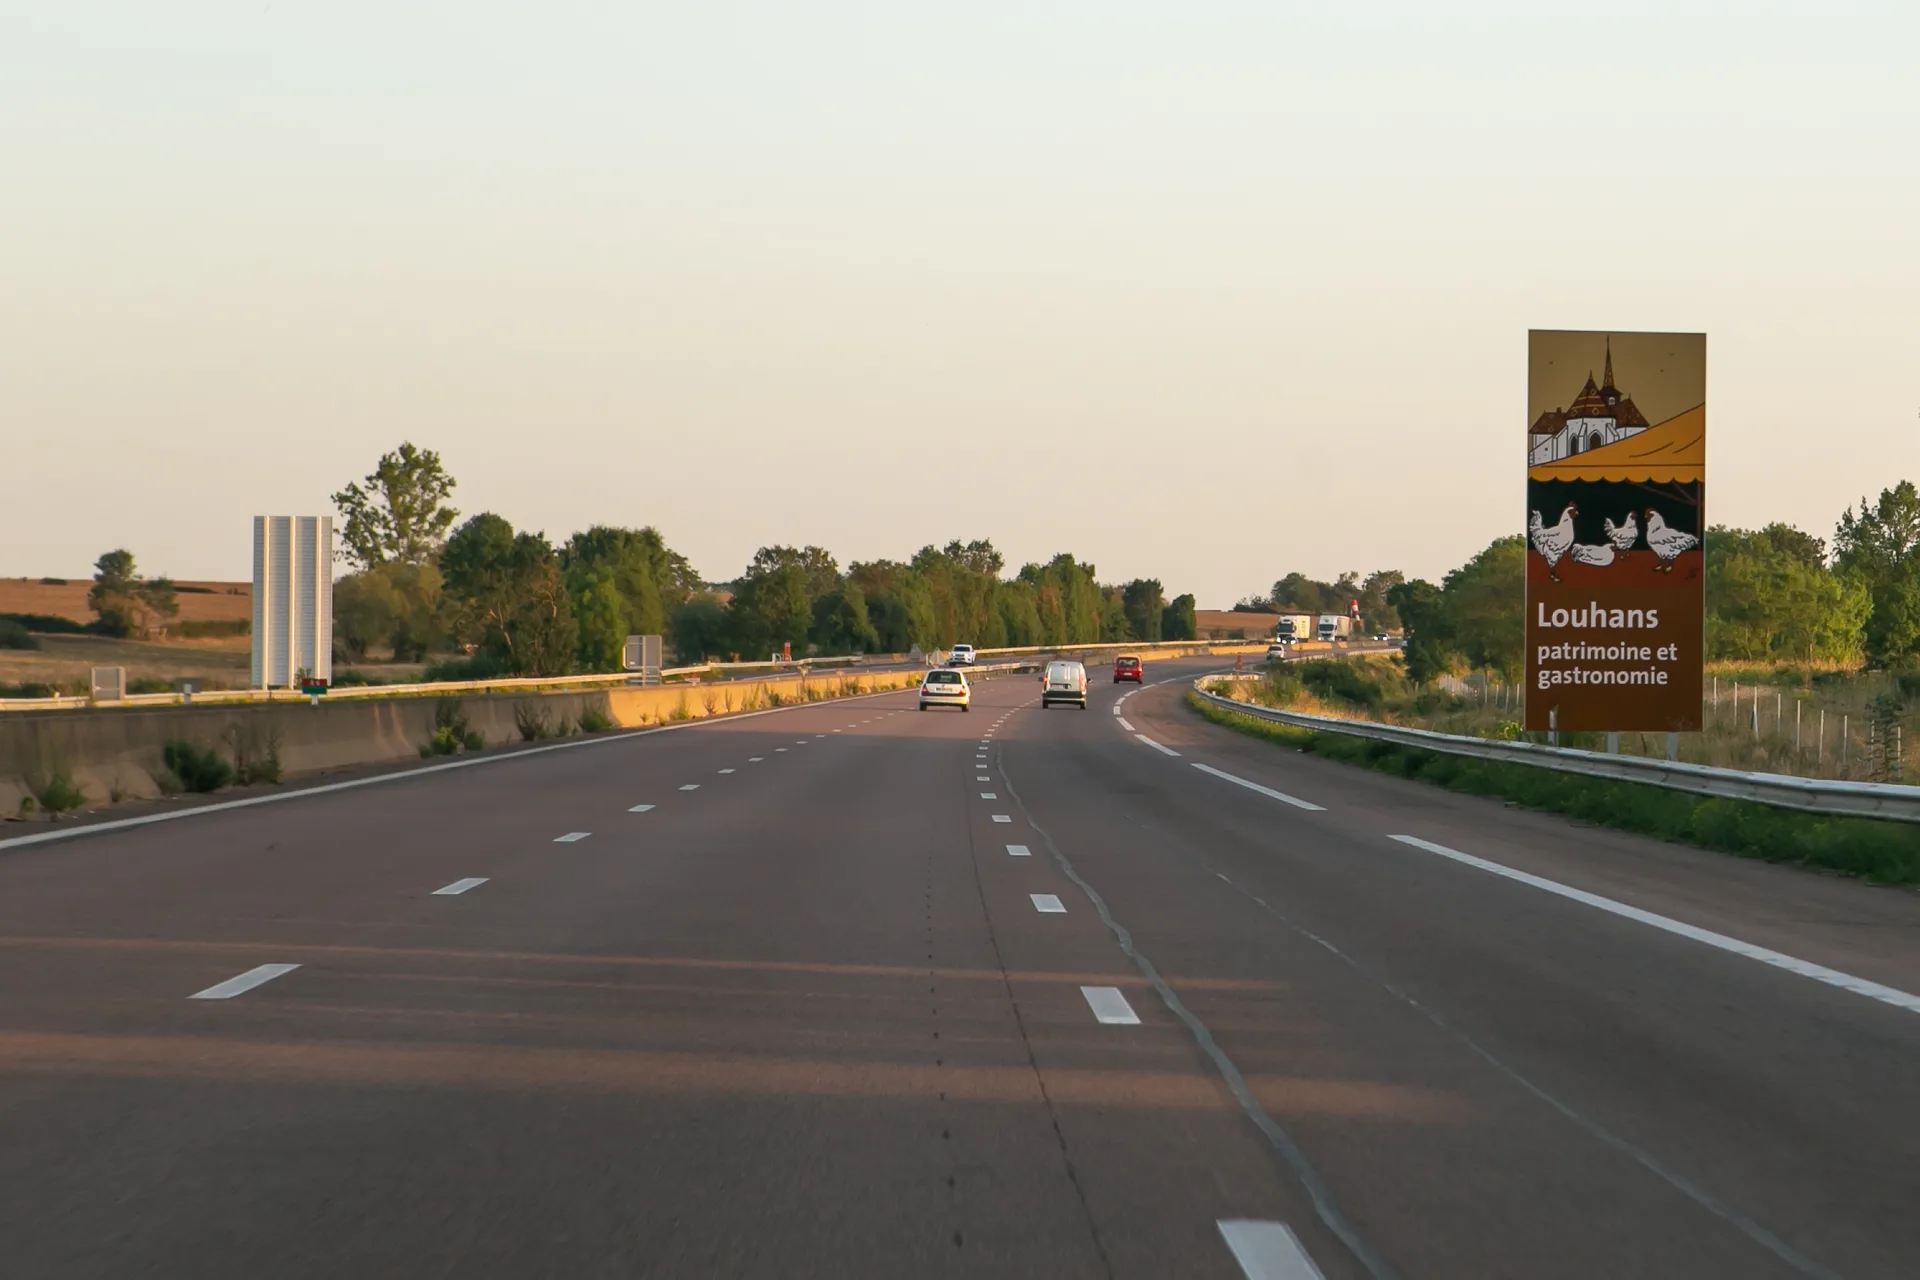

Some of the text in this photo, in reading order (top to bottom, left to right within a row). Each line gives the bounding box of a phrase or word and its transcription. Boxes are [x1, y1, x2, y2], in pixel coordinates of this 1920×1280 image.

[1538, 601, 1659, 629] Louhans
[1538, 641, 1678, 665] patrimoine et
[1538, 666, 1668, 690] gastronomie
